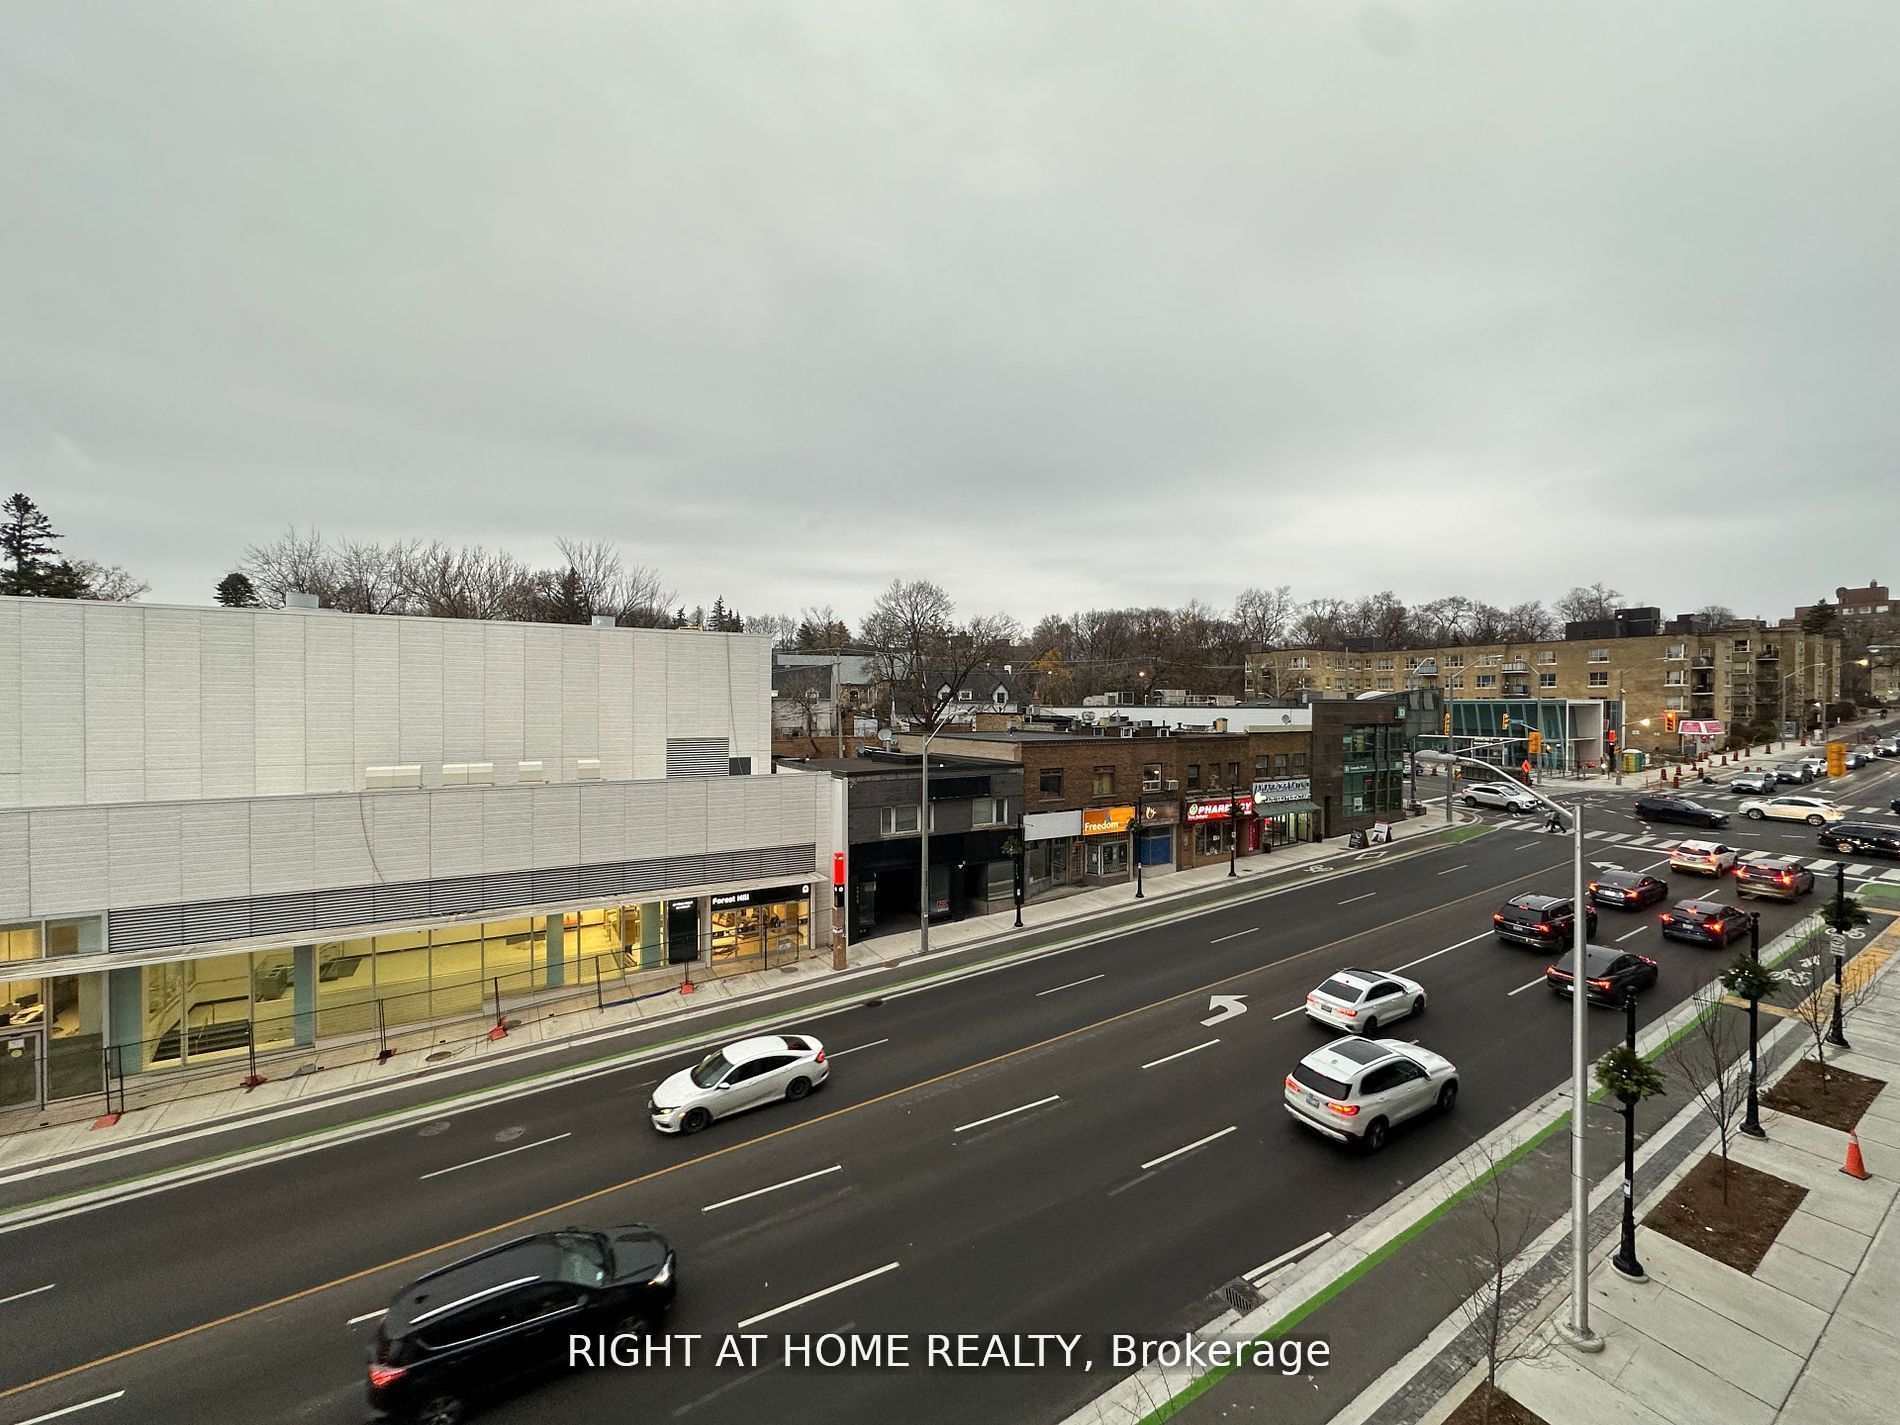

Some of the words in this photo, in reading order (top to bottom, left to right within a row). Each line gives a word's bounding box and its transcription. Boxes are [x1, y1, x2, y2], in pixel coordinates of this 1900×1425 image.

[1084, 819, 1119, 831] Freedom
[712, 896, 736, 905] Forest
[737, 893, 750, 902] Hill
